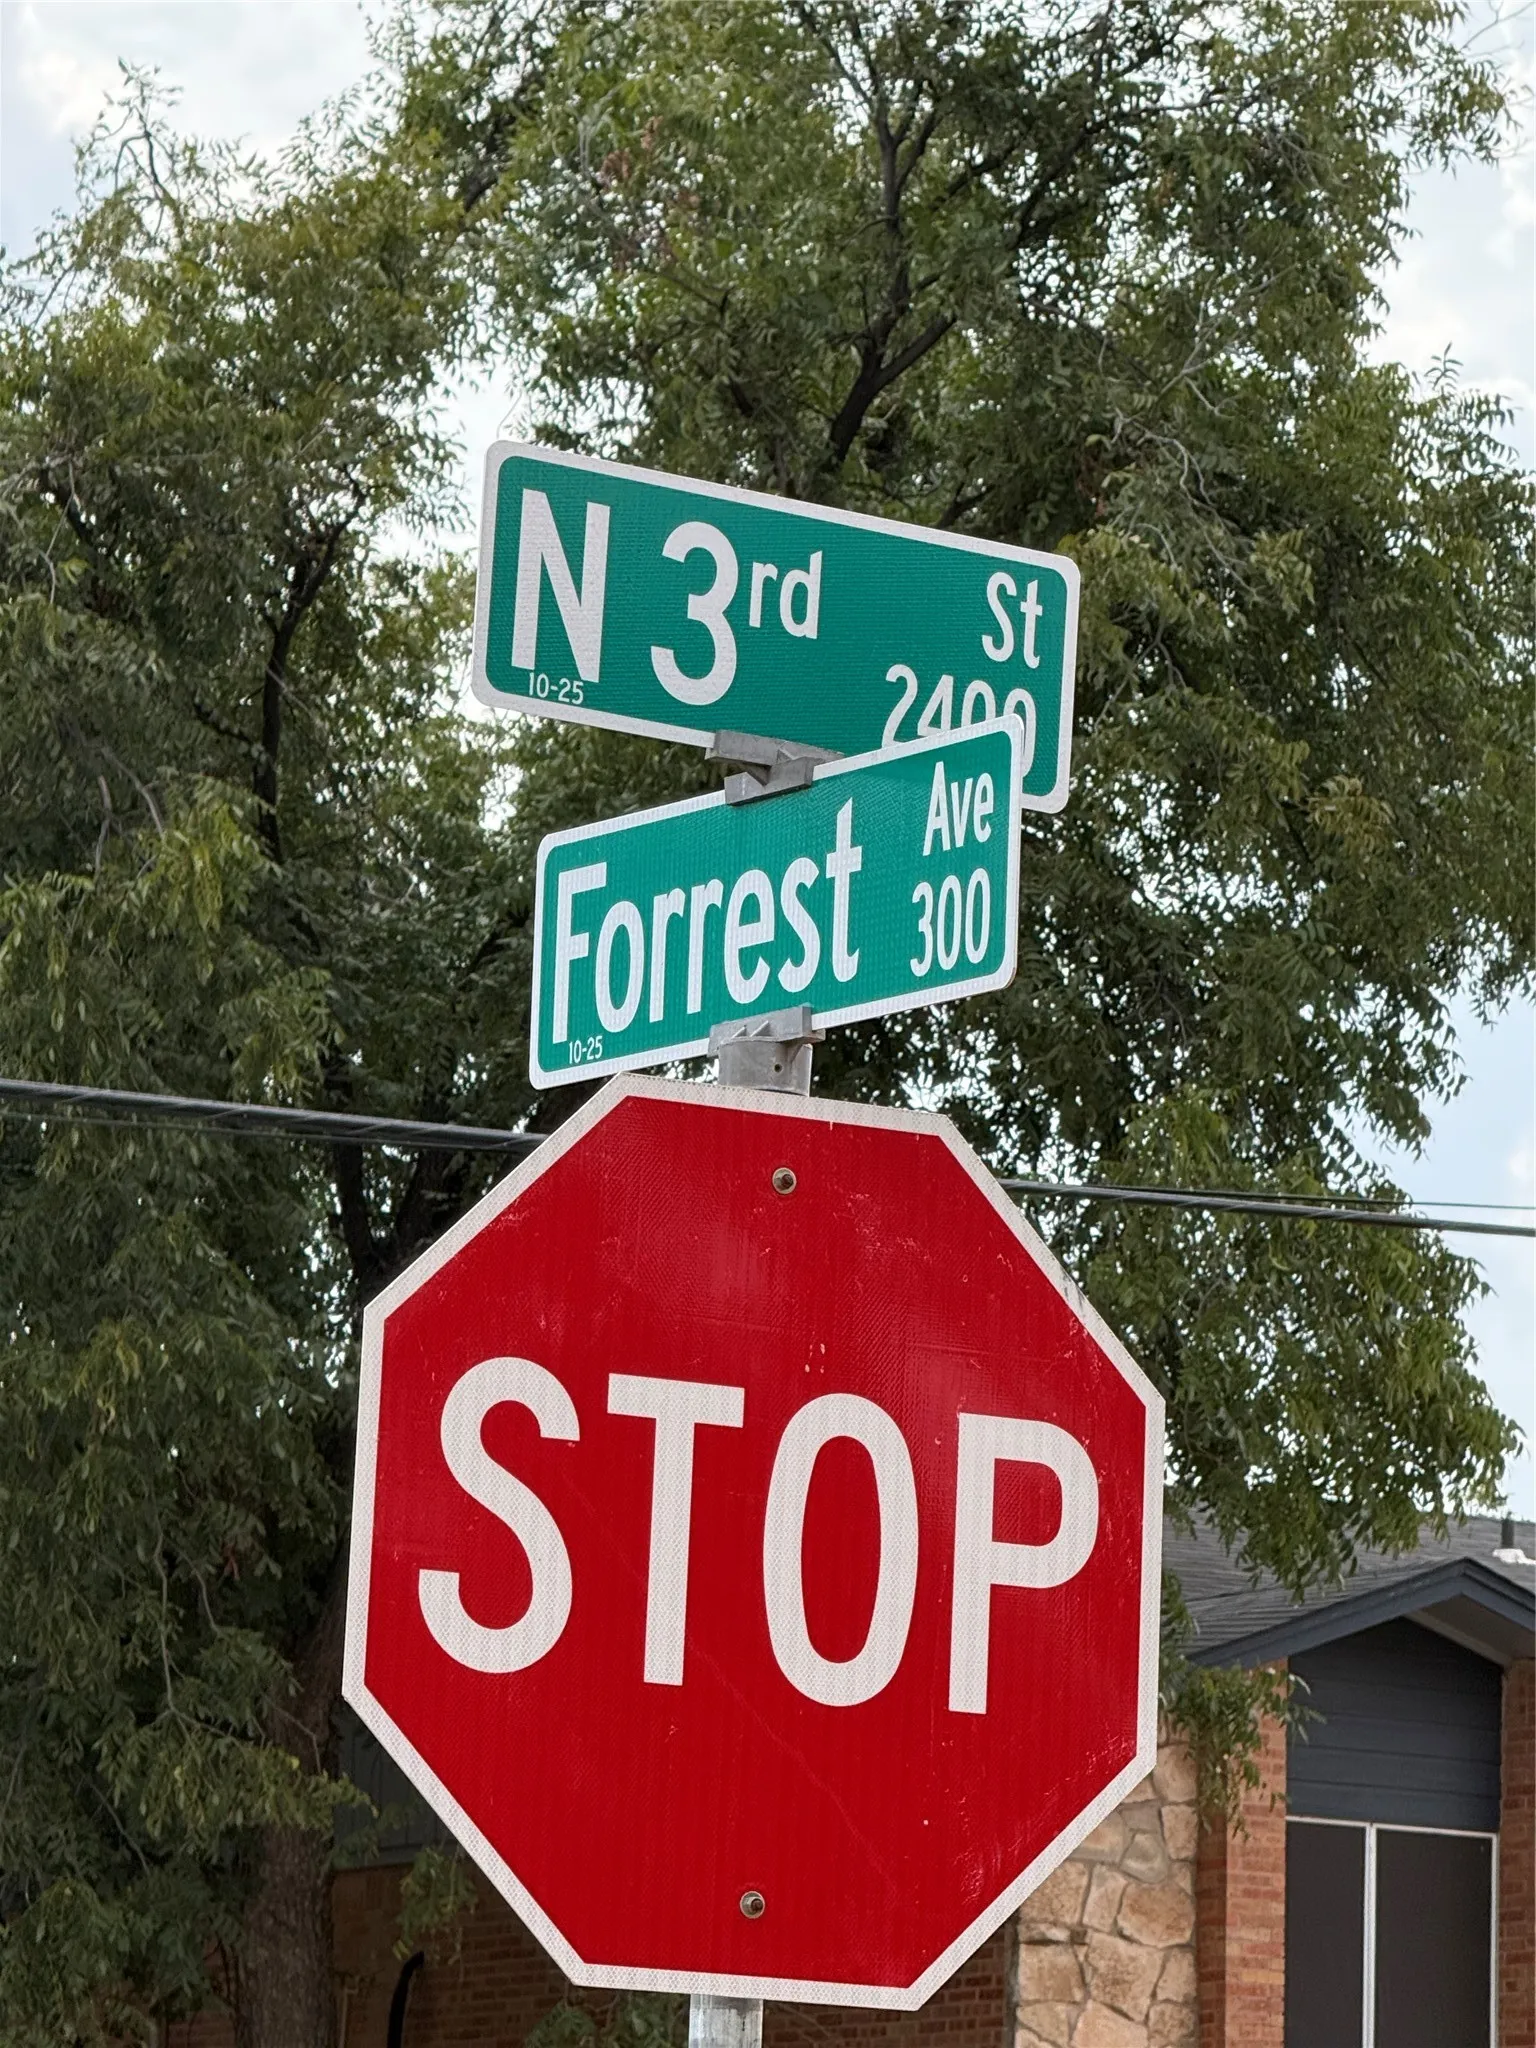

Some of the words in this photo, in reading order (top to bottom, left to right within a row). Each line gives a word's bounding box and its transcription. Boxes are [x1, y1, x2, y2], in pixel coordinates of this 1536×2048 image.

[511, 488, 610, 682] N
[650, 521, 822, 705] 3rd
[982, 572, 1043, 668] St
[529, 672, 584, 704] 10-25
[552, 797, 862, 1044] Forrest
[922, 761, 994, 856] Ave
[910, 868, 991, 977] 300
[569, 1036, 603, 1064] 10-25
[418, 1356, 1100, 1714] STOP
